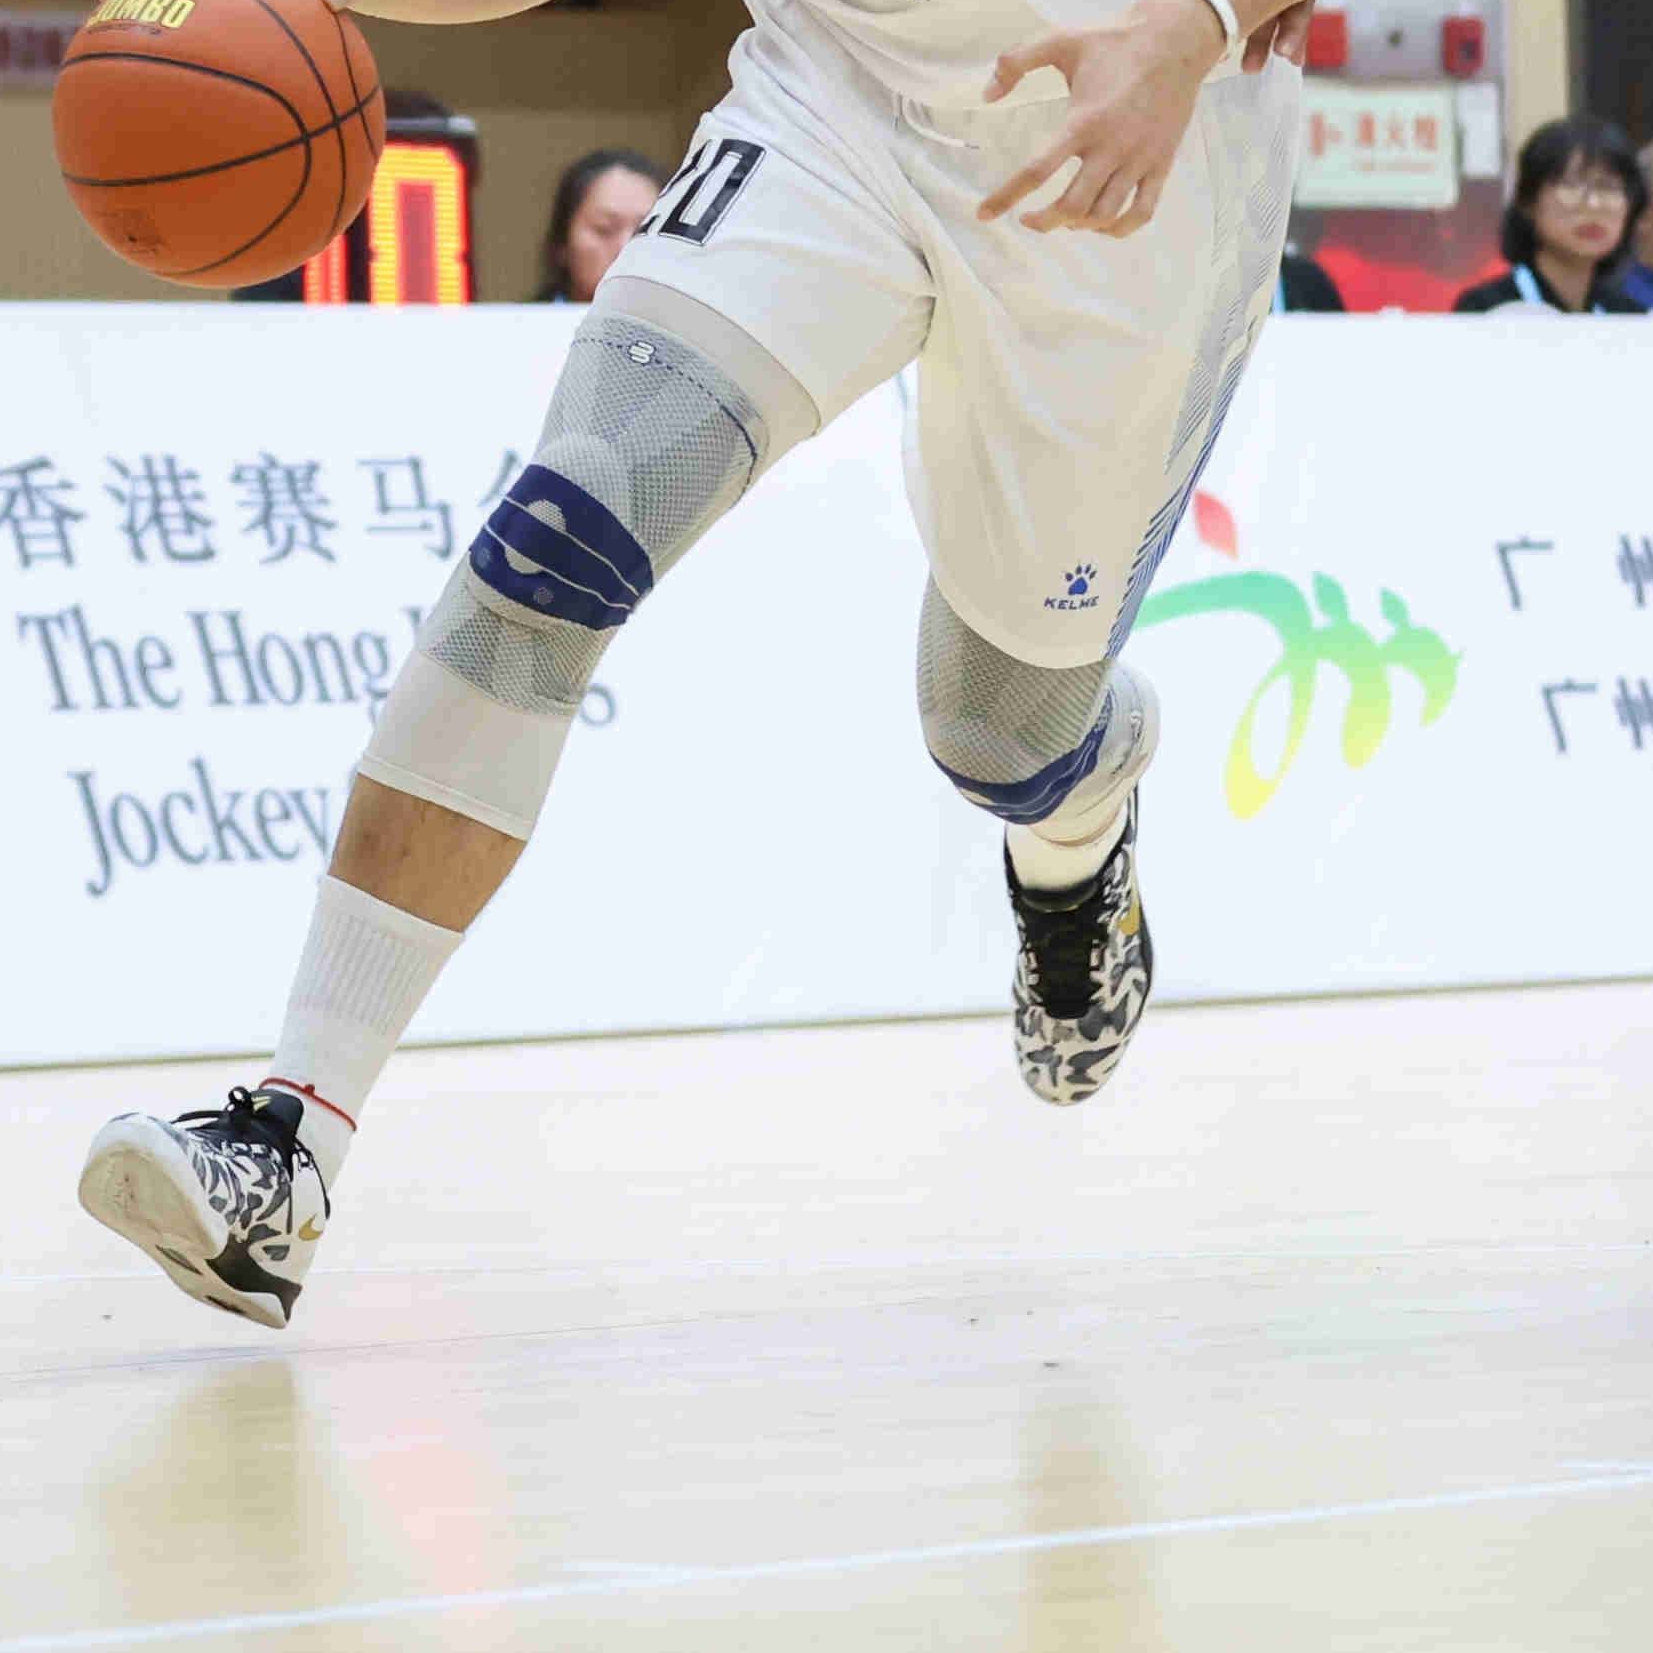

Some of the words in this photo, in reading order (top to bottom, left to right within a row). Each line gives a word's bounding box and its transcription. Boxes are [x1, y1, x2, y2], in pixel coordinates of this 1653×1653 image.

[1044, 594, 1100, 611] KELME
[18, 604, 181, 714] The
[186, 608, 392, 726] Hong
[67, 758, 331, 898] Jockey
